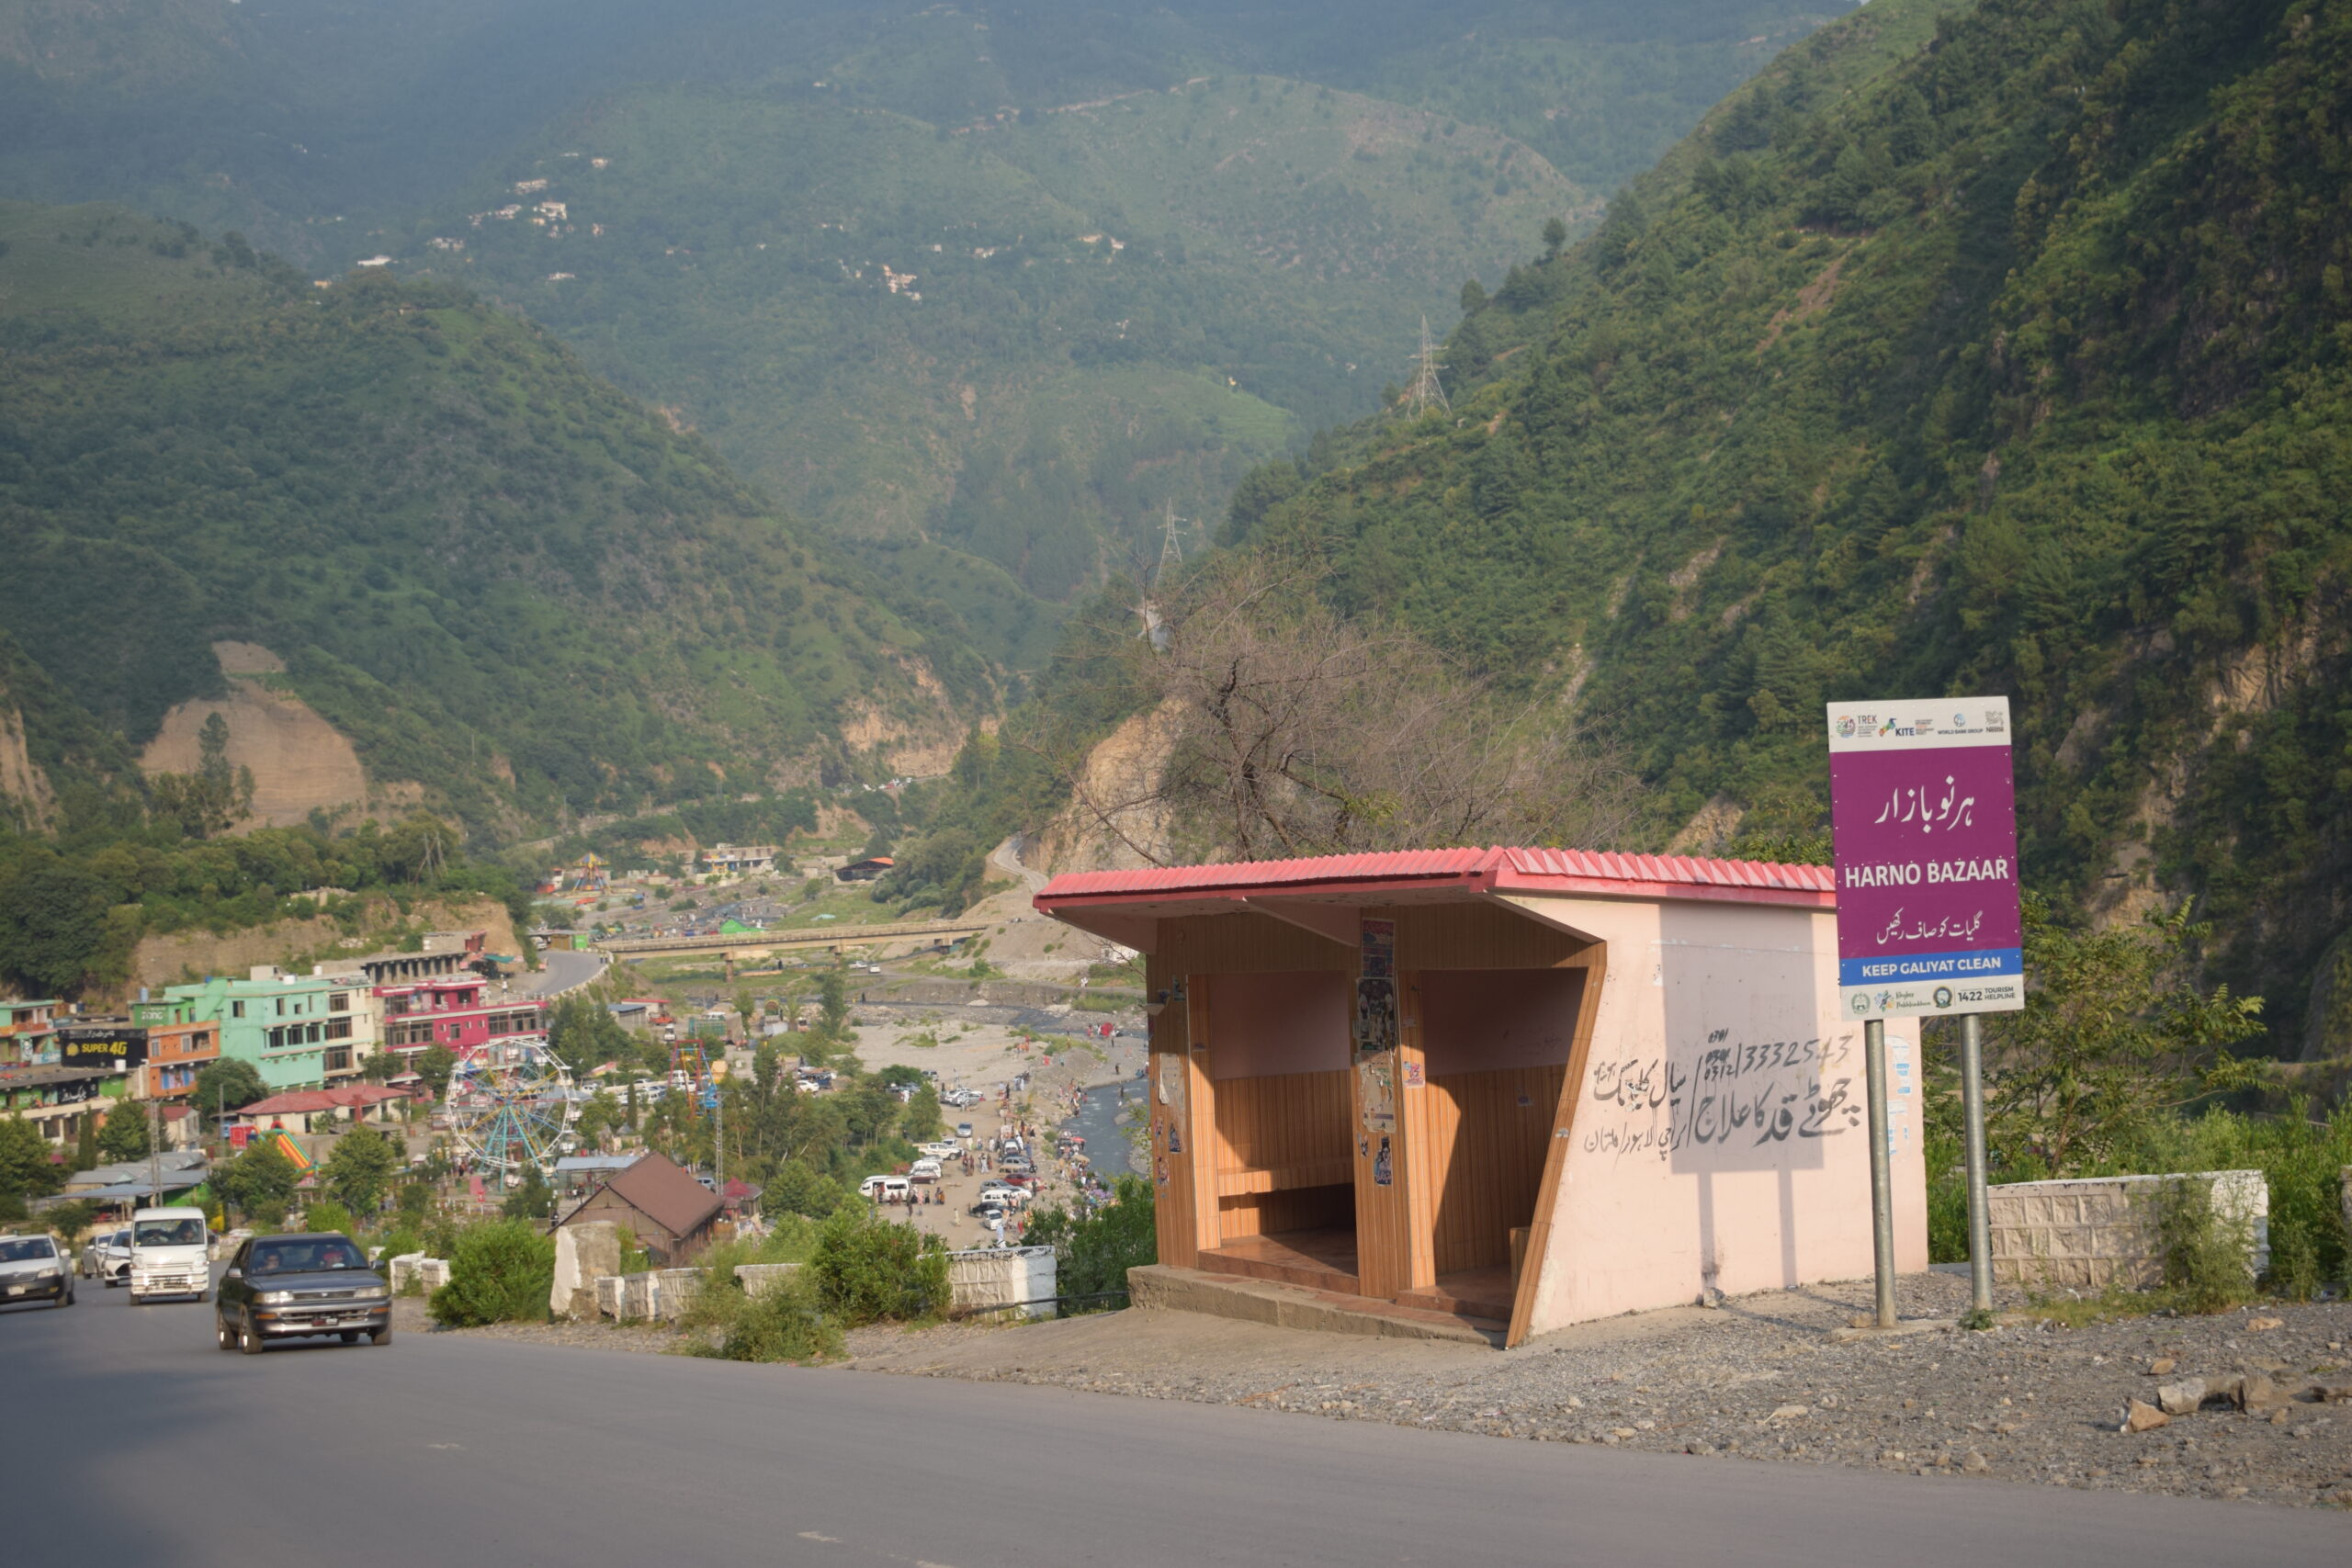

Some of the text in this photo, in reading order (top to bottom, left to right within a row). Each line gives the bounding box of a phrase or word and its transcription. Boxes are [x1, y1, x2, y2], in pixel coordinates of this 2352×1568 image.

[1858, 715, 1878, 725] TREK
[1895, 728, 1915, 737] KITE
[1874, 774, 1975, 834] ہرنو بازار
[1845, 858, 2009, 888] HARNO BAZAAR
[1905, 920, 1937, 940] صاف
[1937, 916, 1950, 938] کو
[1948, 909, 1984, 942] گلیات
[1862, 956, 2002, 977] KEEP GALIYAT CLEAN
[1958, 990, 1984, 1002] 1422
[1984, 992, 2016, 1000] HELPLINE
[82, 1043, 108, 1054] SUPER
[109, 1041, 128, 1055] 4G
[1704, 1065, 1735, 1081] 0312
[1694, 1089, 1751, 1145] علاج
